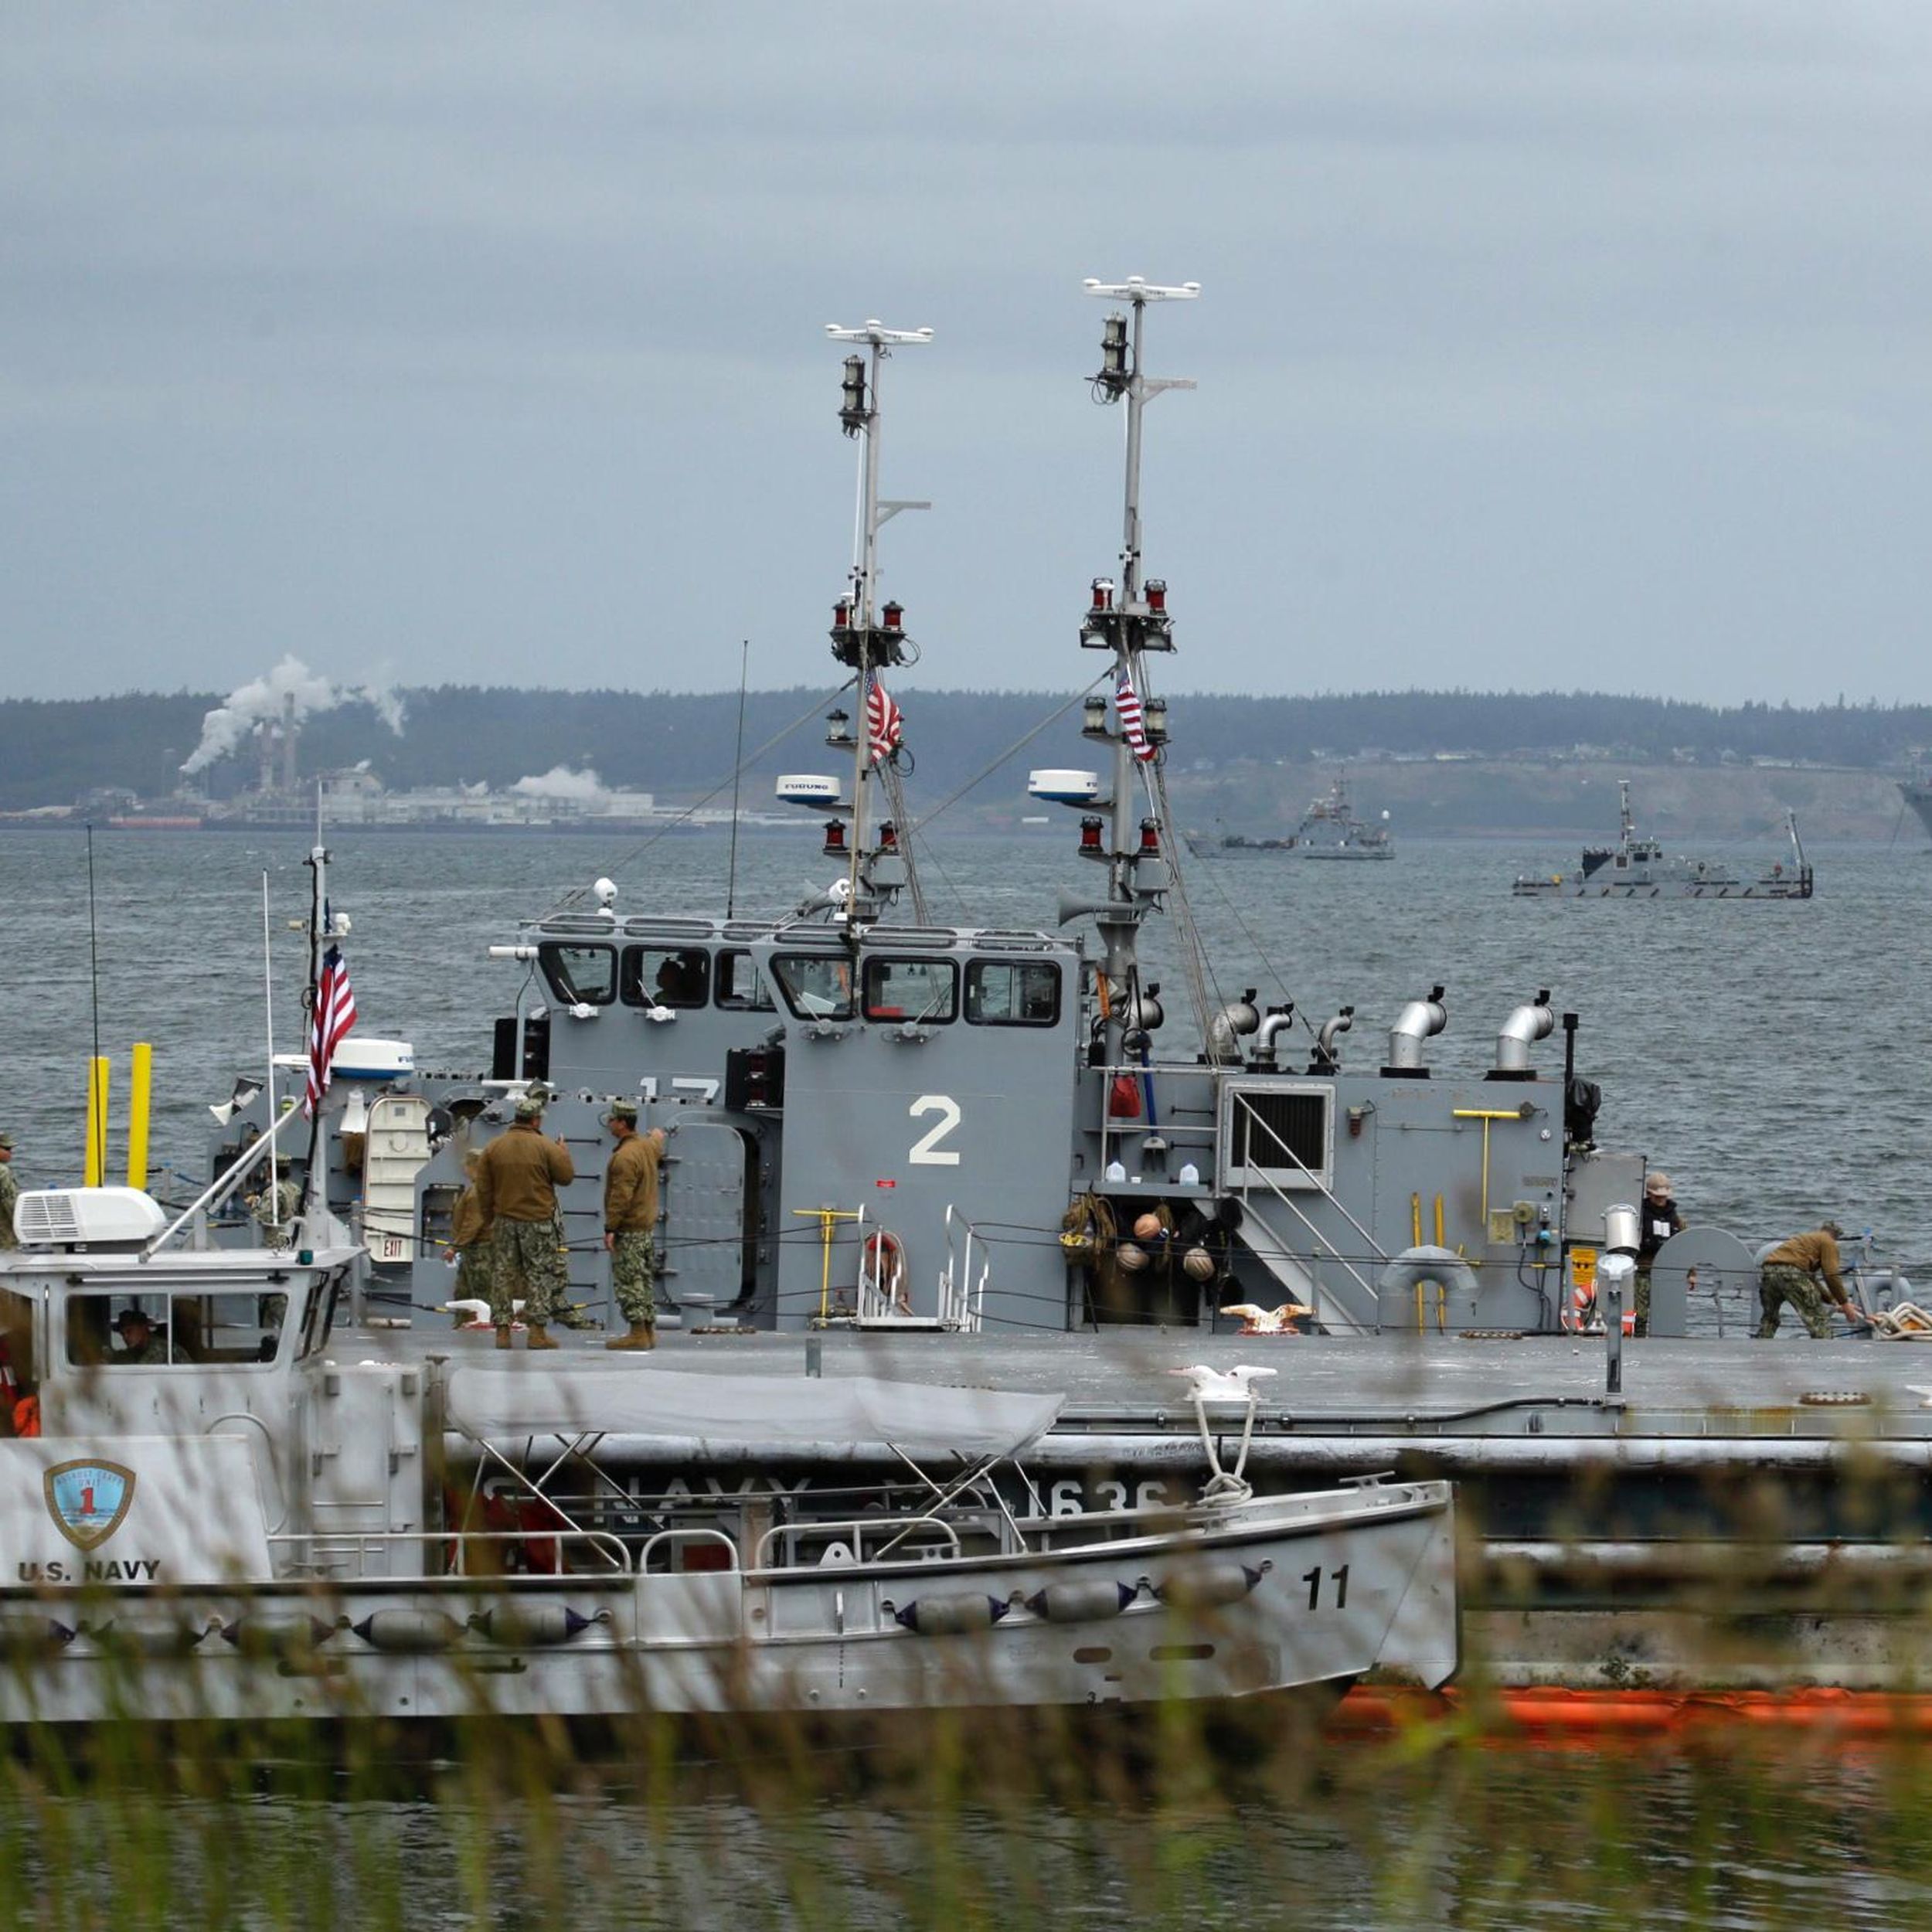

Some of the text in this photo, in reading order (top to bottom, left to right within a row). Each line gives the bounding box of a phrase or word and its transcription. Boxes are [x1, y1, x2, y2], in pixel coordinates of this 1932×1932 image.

[909, 1095, 961, 1165] 2
[384, 1240, 402, 1257] EXIT
[80, 1488, 96, 1514] 1
[18, 1560, 160, 1581] U.S. NAVY
[1303, 1564, 1349, 1611] 11
